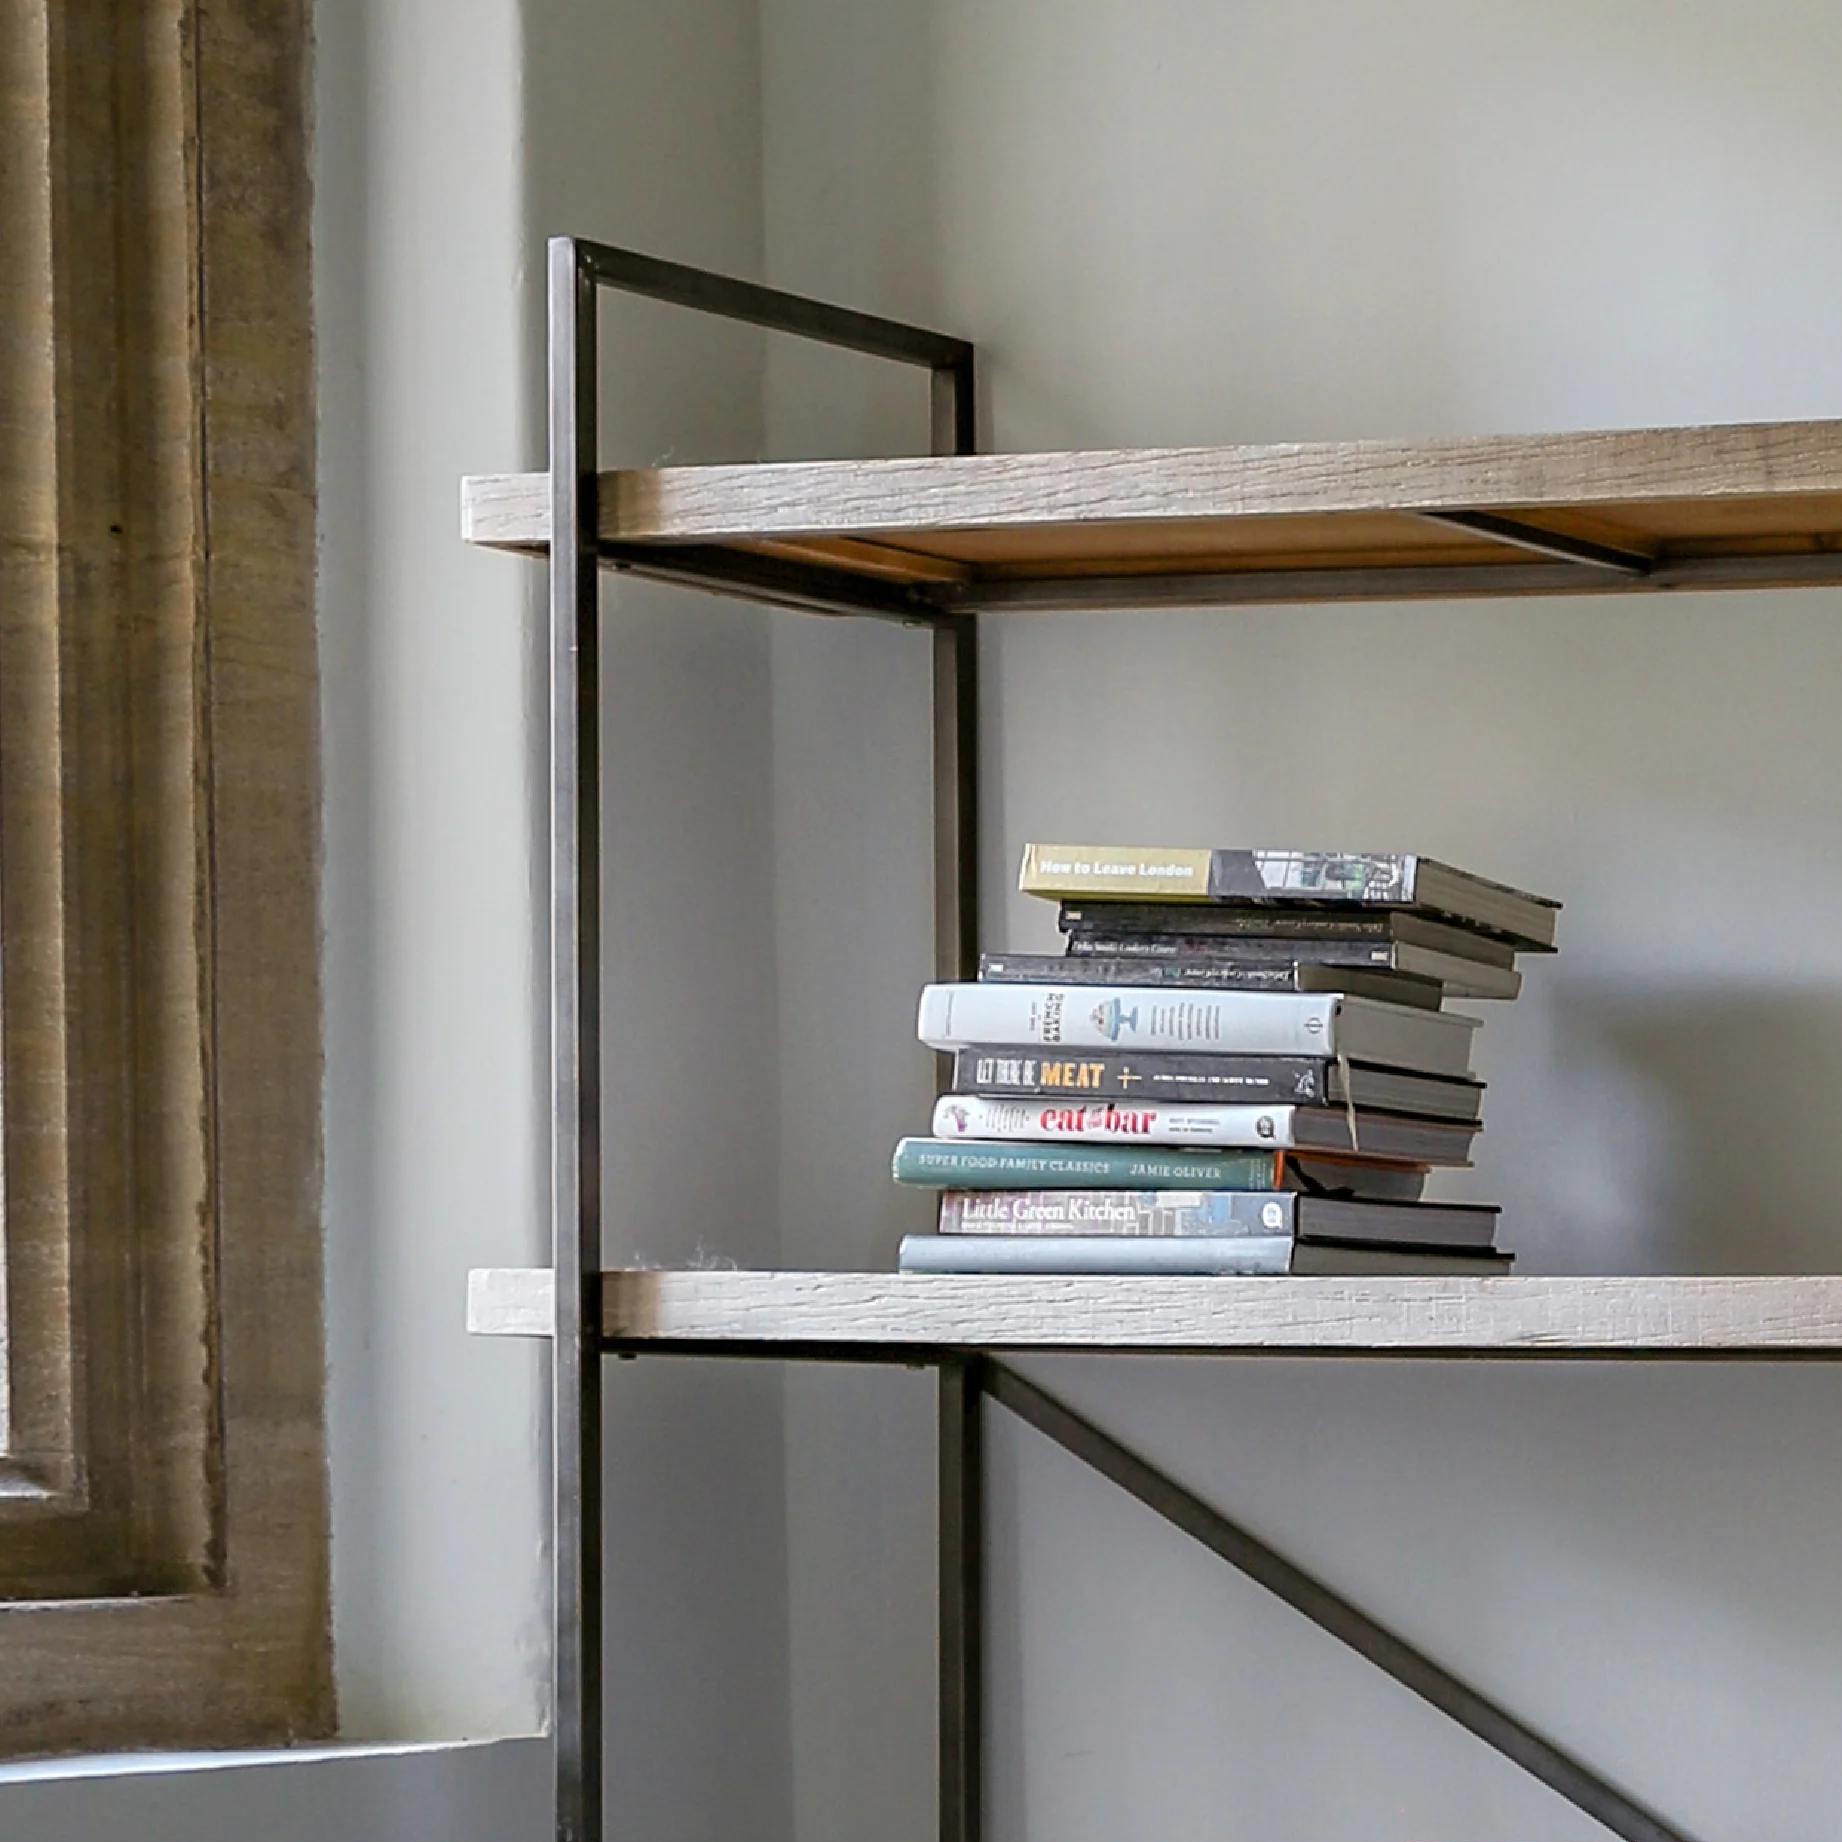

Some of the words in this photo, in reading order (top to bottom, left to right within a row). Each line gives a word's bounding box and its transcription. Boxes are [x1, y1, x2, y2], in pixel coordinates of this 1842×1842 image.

[1040, 860, 1071, 875] How
[1074, 861, 1090, 875] to
[1094, 862, 1136, 876] Leave
[1139, 863, 1193, 877] London
[1040, 1061, 1106, 1089] MEAT
[1040, 1104, 1087, 1133] eat
[1104, 1103, 1157, 1135] bar
[919, 1153, 959, 1168] SUPER
[961, 1154, 998, 1169] FOOD
[1000, 1156, 1048, 1172] FAMILY
[1049, 1158, 1110, 1175] CLASSICS
[1130, 1162, 1171, 1177] JAMIE
[1175, 1164, 1222, 1180] OLIVER
[961, 1196, 1008, 1220] Little
[1012, 1198, 1065, 1221] Green
[1068, 1199, 1136, 1222] Kitchen
